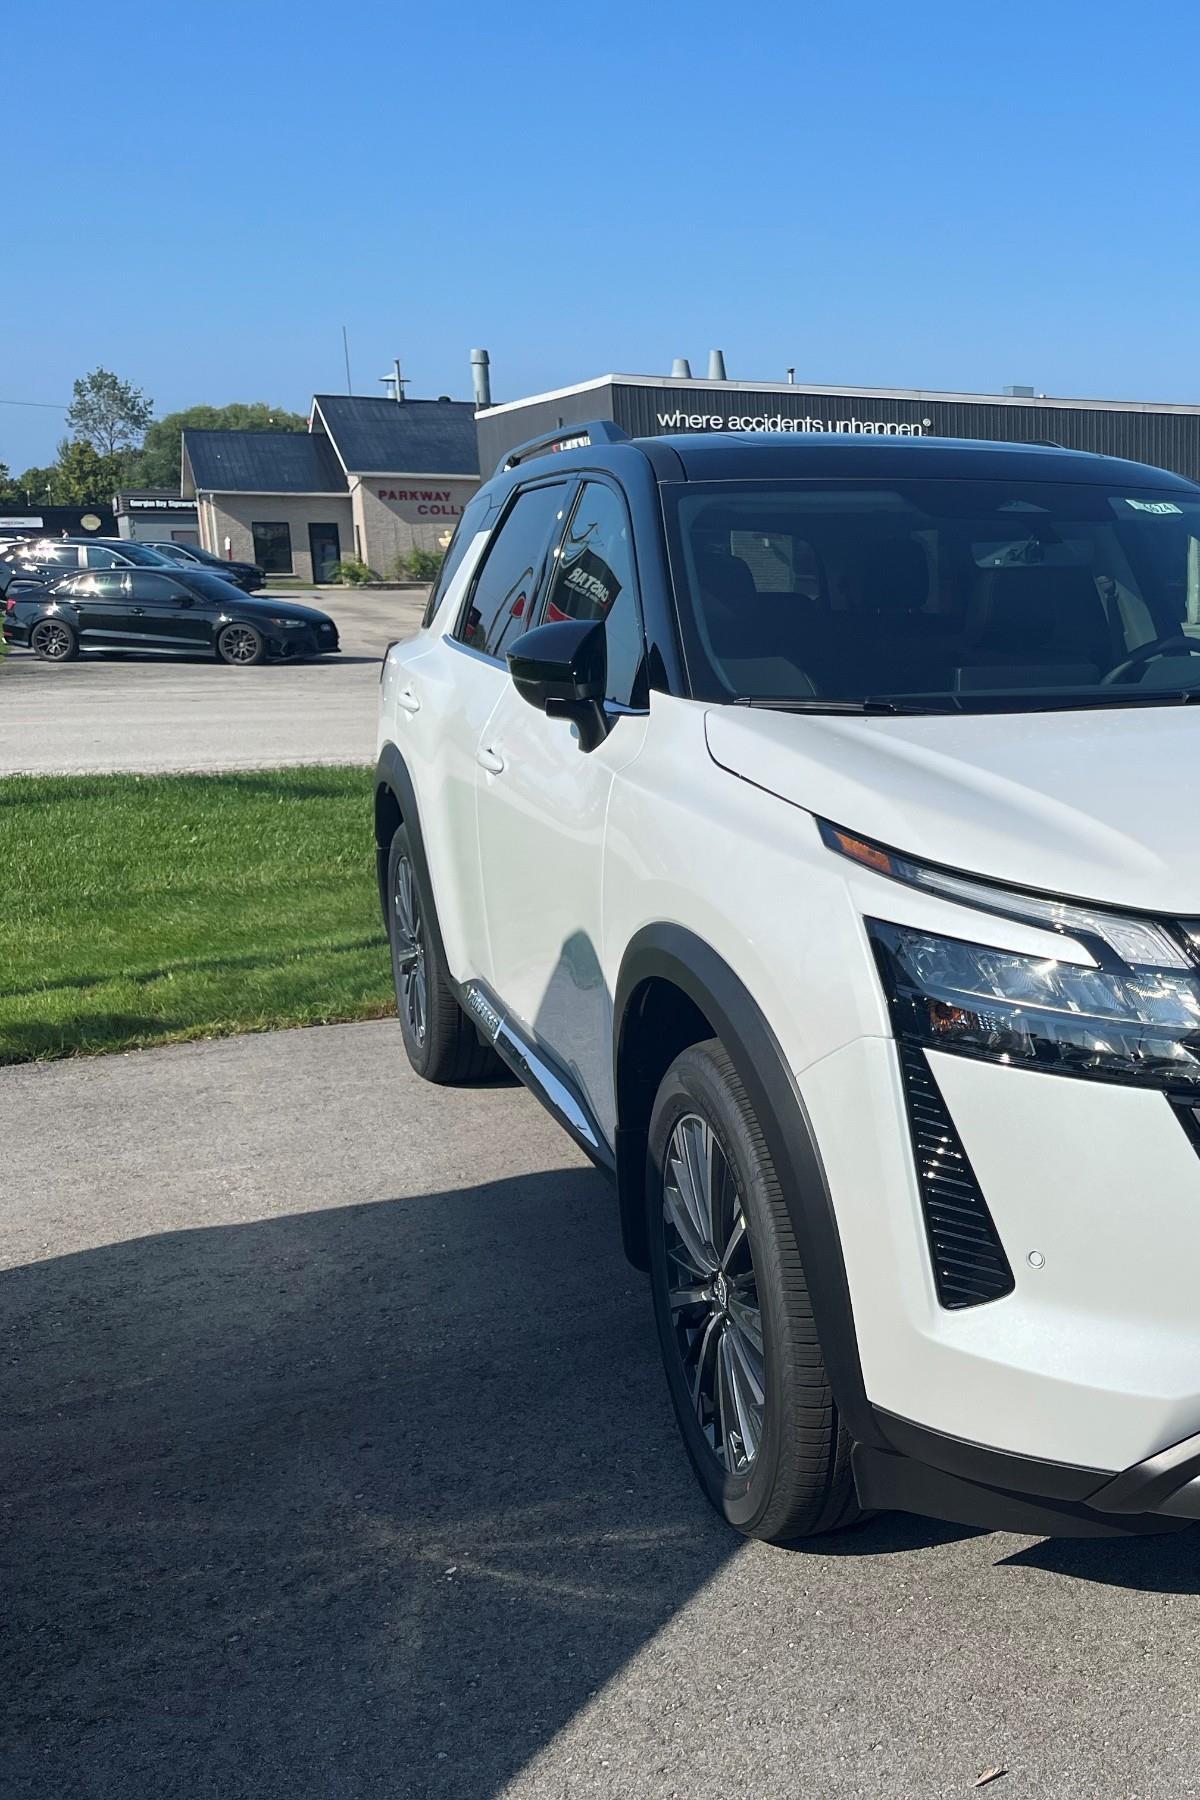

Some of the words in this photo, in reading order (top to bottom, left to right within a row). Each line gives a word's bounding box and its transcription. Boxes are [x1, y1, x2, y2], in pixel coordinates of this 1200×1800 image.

[657, 410, 723, 429] where
[728, 414, 823, 432] accidents
[378, 490, 451, 502] PARKWAY
